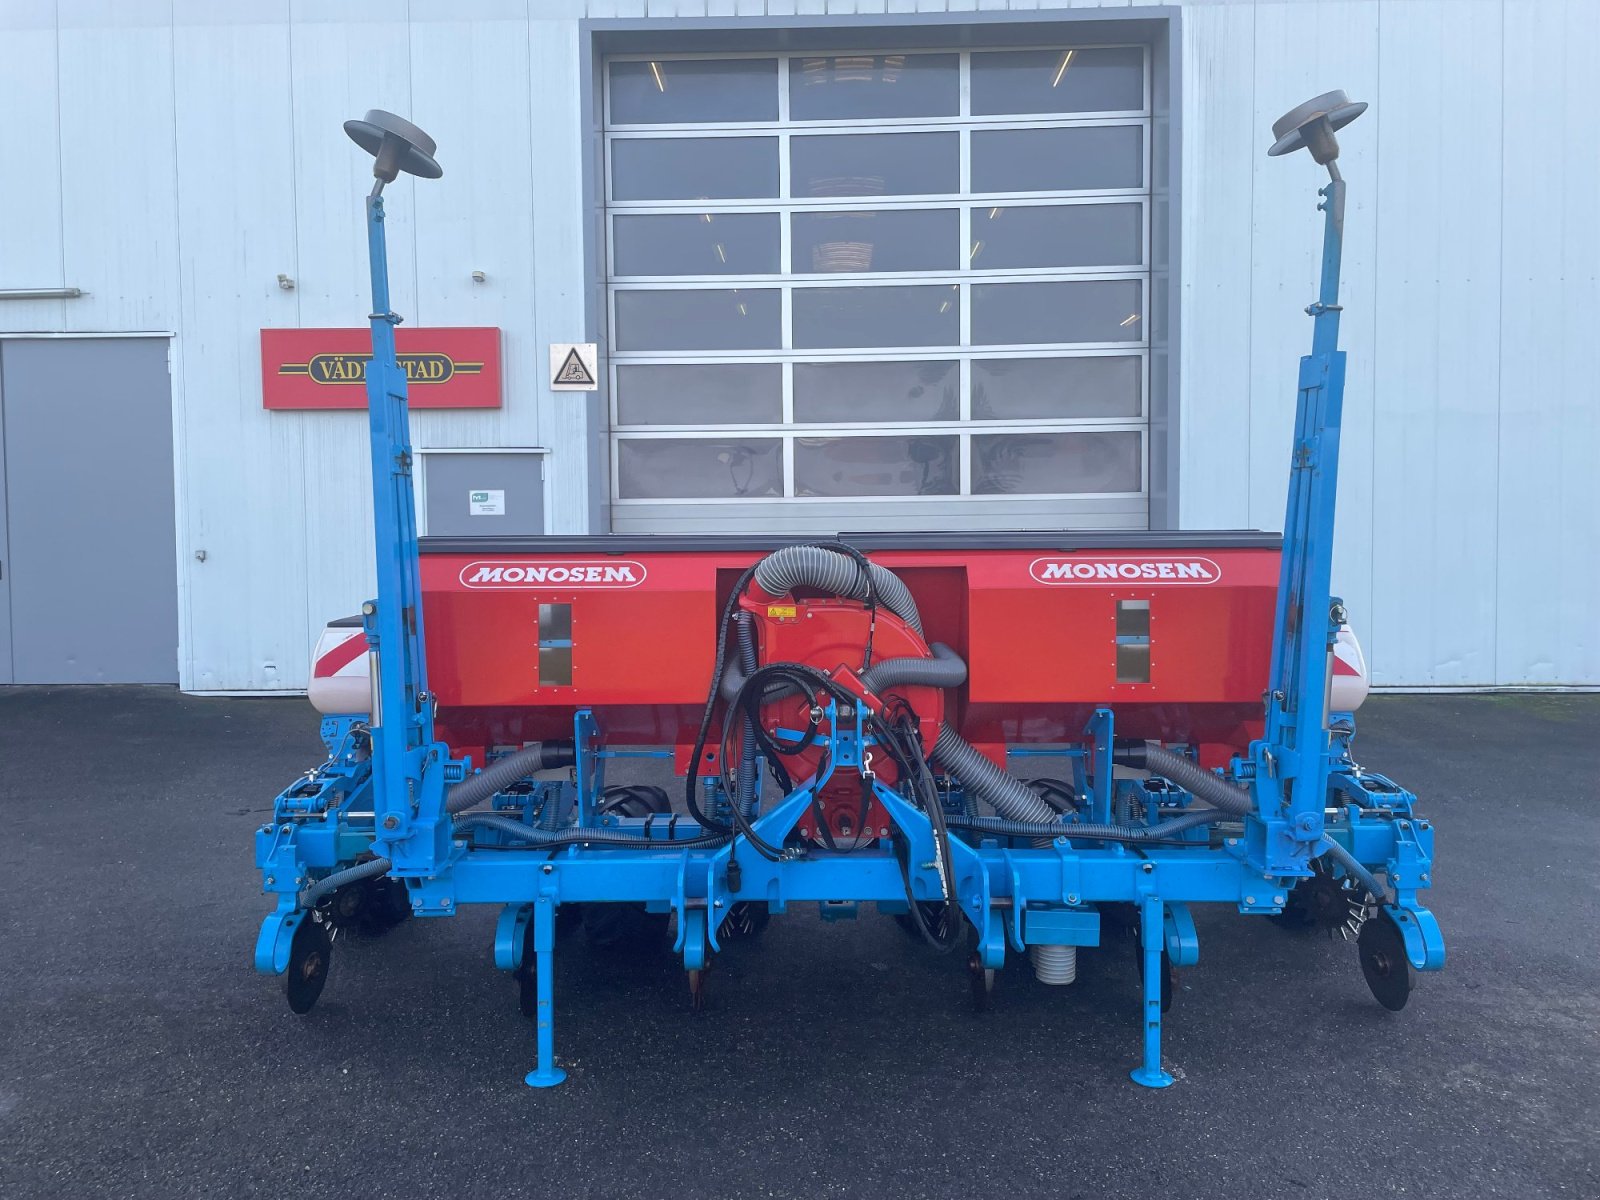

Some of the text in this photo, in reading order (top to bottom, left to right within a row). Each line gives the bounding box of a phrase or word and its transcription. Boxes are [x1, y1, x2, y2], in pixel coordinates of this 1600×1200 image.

[320, 356, 444, 379] VÄDTAD
[469, 567, 636, 582] MONOSEM
[1041, 563, 1212, 579] MONOSEM
